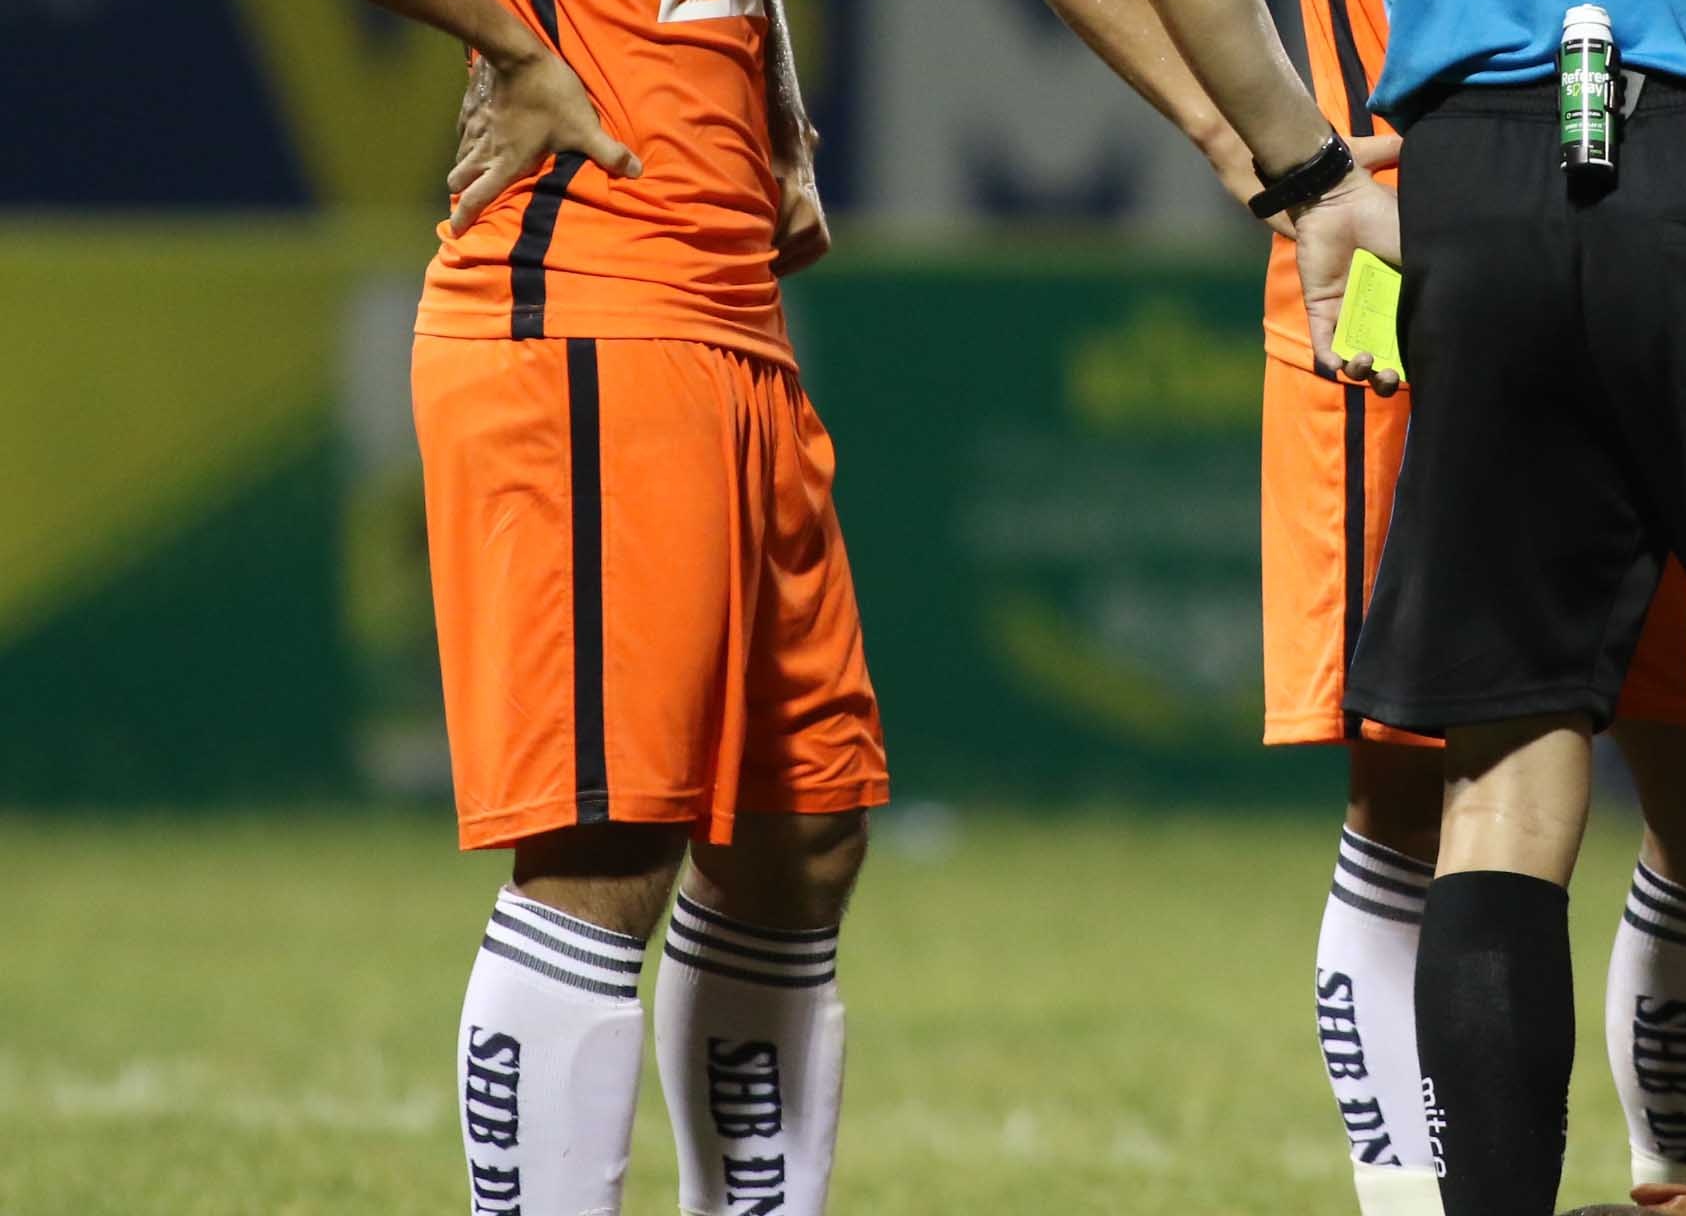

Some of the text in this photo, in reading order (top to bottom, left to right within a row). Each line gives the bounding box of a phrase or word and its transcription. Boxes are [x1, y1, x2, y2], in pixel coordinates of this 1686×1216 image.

[466, 1024, 522, 1151] SHB
[706, 1037, 783, 1139] SHB
[1316, 967, 1403, 1168] SHB DN
